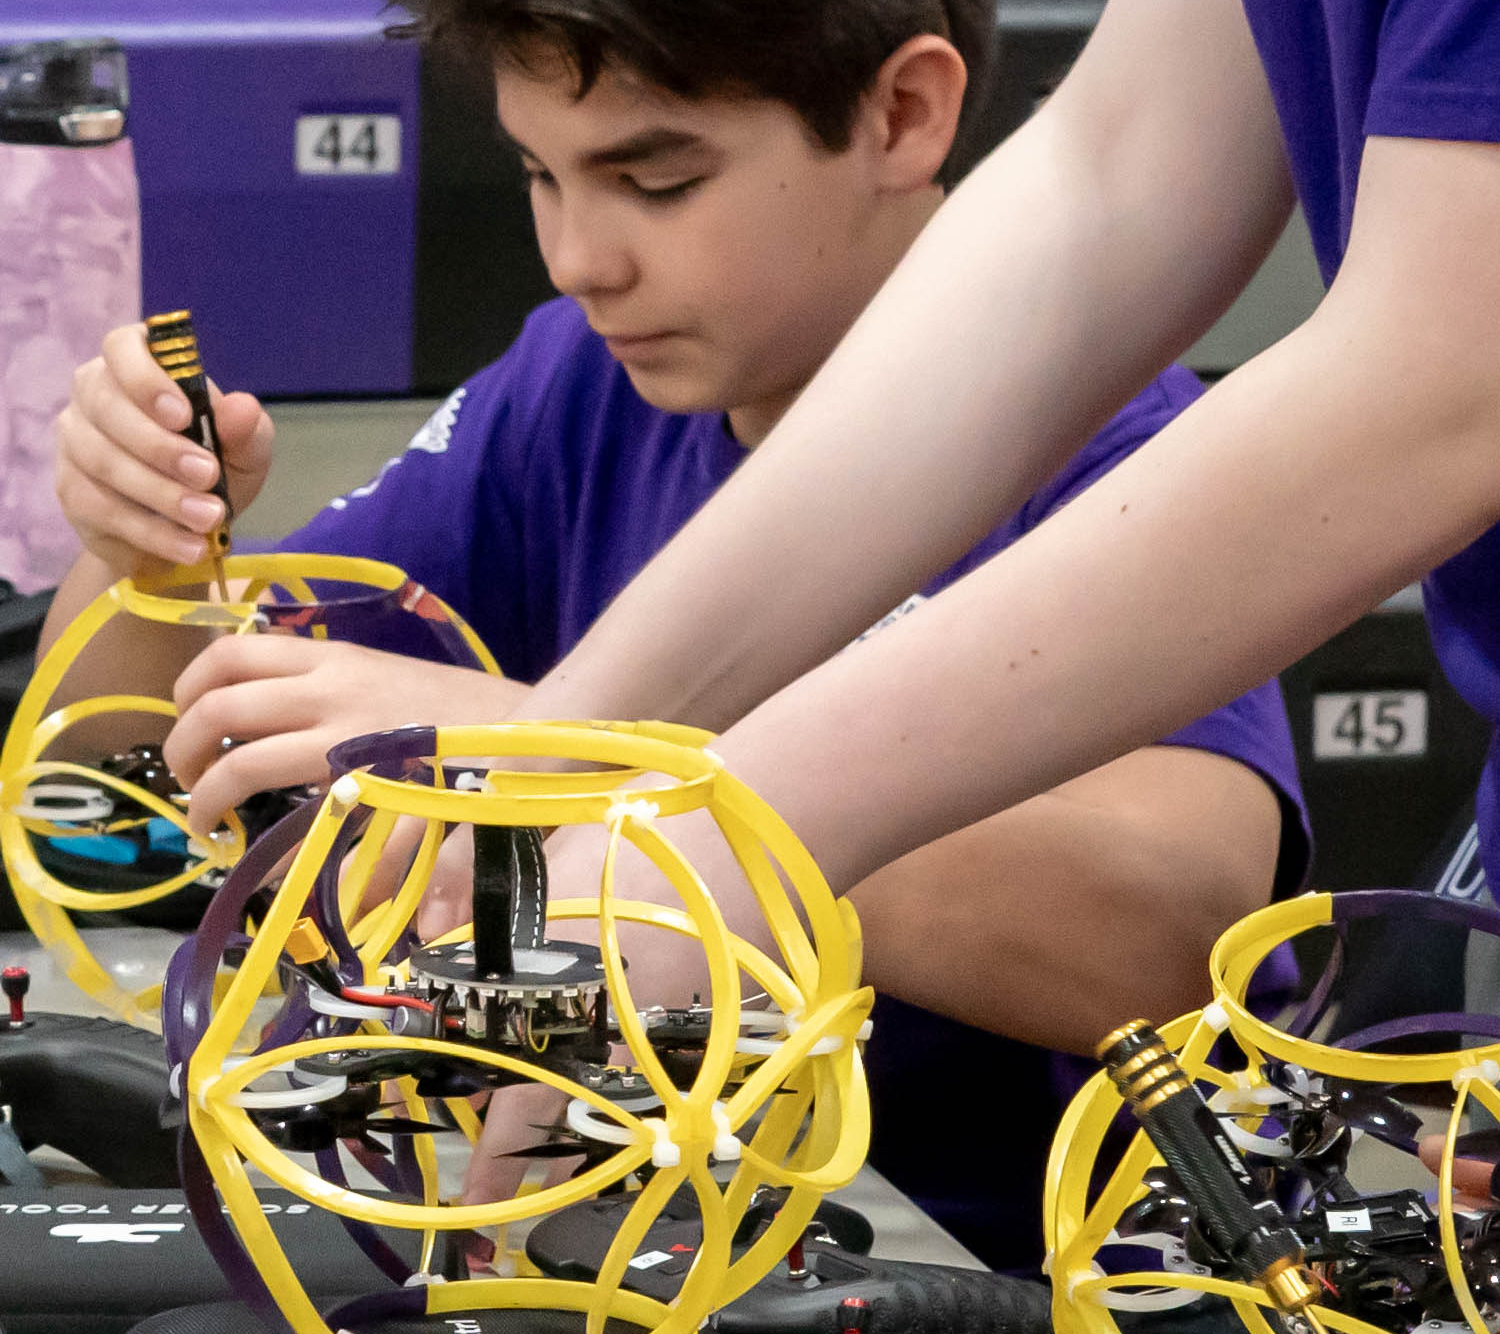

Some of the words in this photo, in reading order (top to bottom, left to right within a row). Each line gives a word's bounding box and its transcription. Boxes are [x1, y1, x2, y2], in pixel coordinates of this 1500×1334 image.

[311, 121, 382, 170] 44
[1332, 700, 1407, 753] 45
[130, 1203, 312, 1216] SOER
